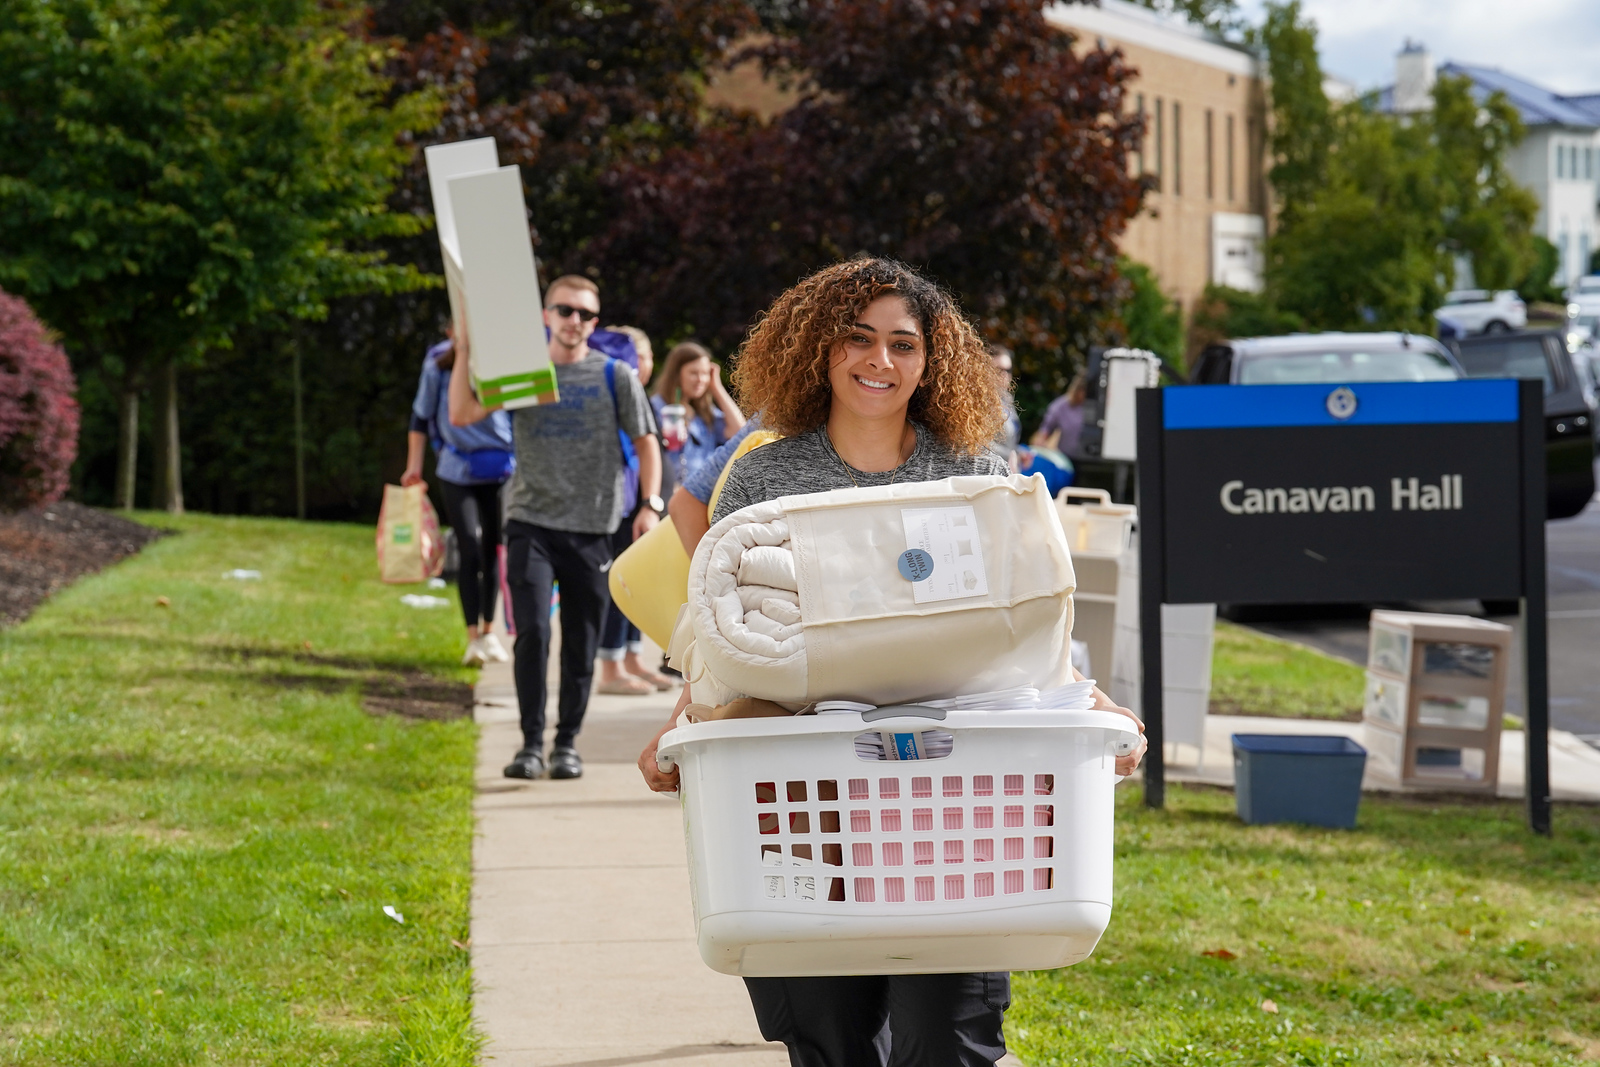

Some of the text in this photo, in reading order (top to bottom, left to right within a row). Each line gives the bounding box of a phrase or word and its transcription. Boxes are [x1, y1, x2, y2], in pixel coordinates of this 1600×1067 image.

[1219, 474, 1464, 515] Canavan Hall
[905, 552, 921, 580] X-LONG
[914, 553, 927, 573] TWIN
